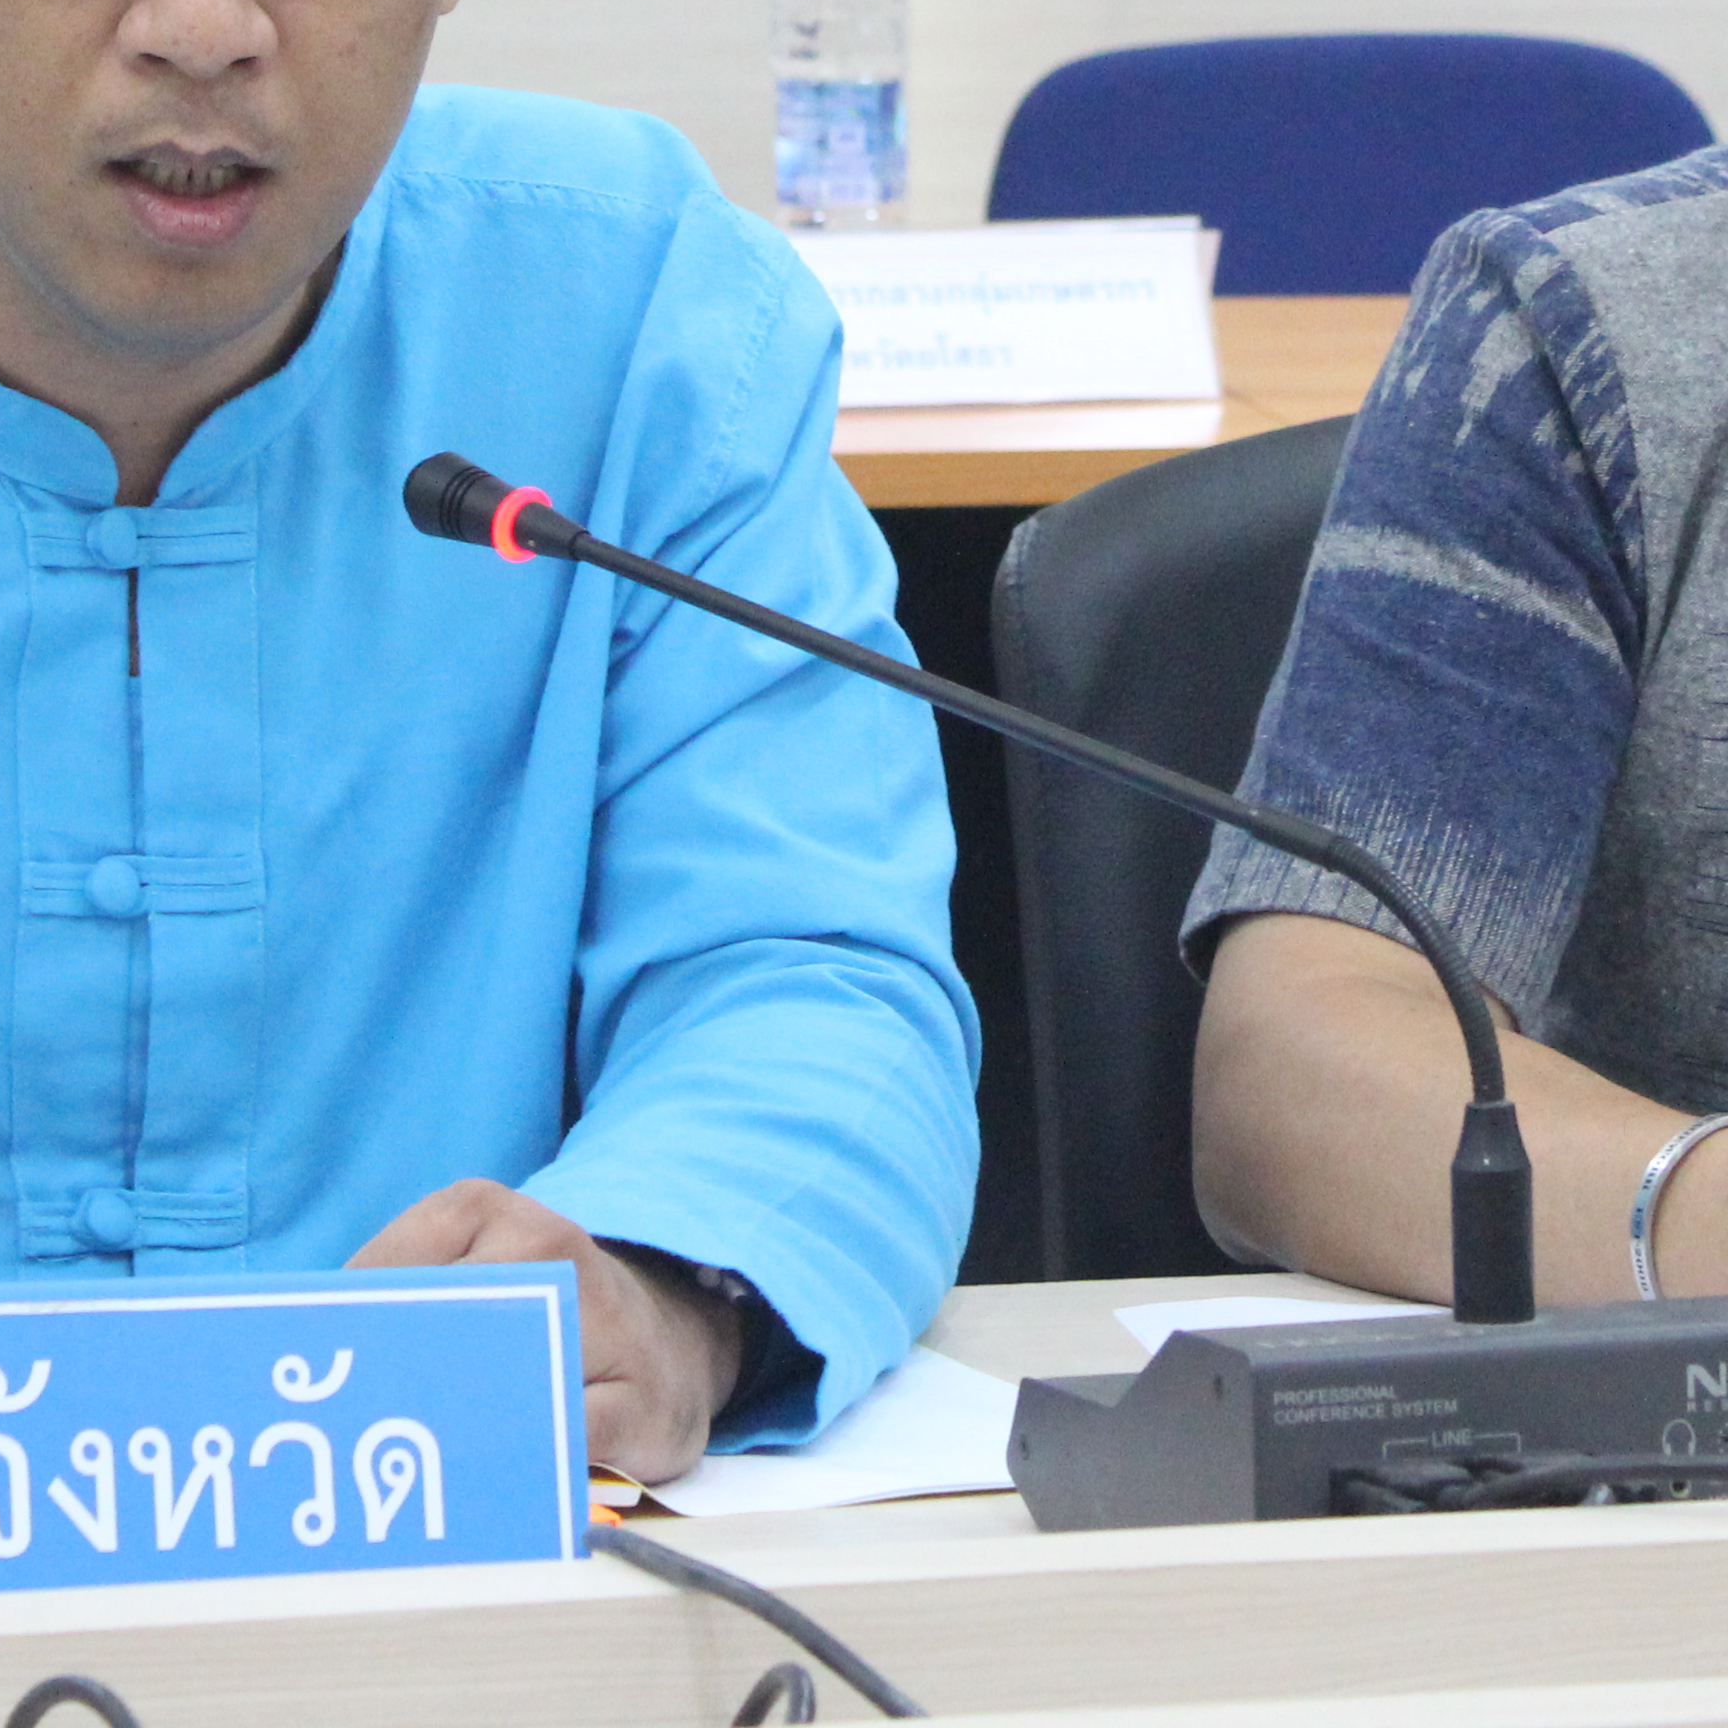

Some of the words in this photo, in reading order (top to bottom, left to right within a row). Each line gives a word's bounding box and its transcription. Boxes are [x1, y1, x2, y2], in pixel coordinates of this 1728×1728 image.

[1273, 1385, 1396, 1406] PROFESSIONAL
[1273, 1402, 1386, 1425] CONFERENCE
[1391, 1399, 1458, 1418] SYSTEM
[1432, 1428, 1471, 1448] LINE
